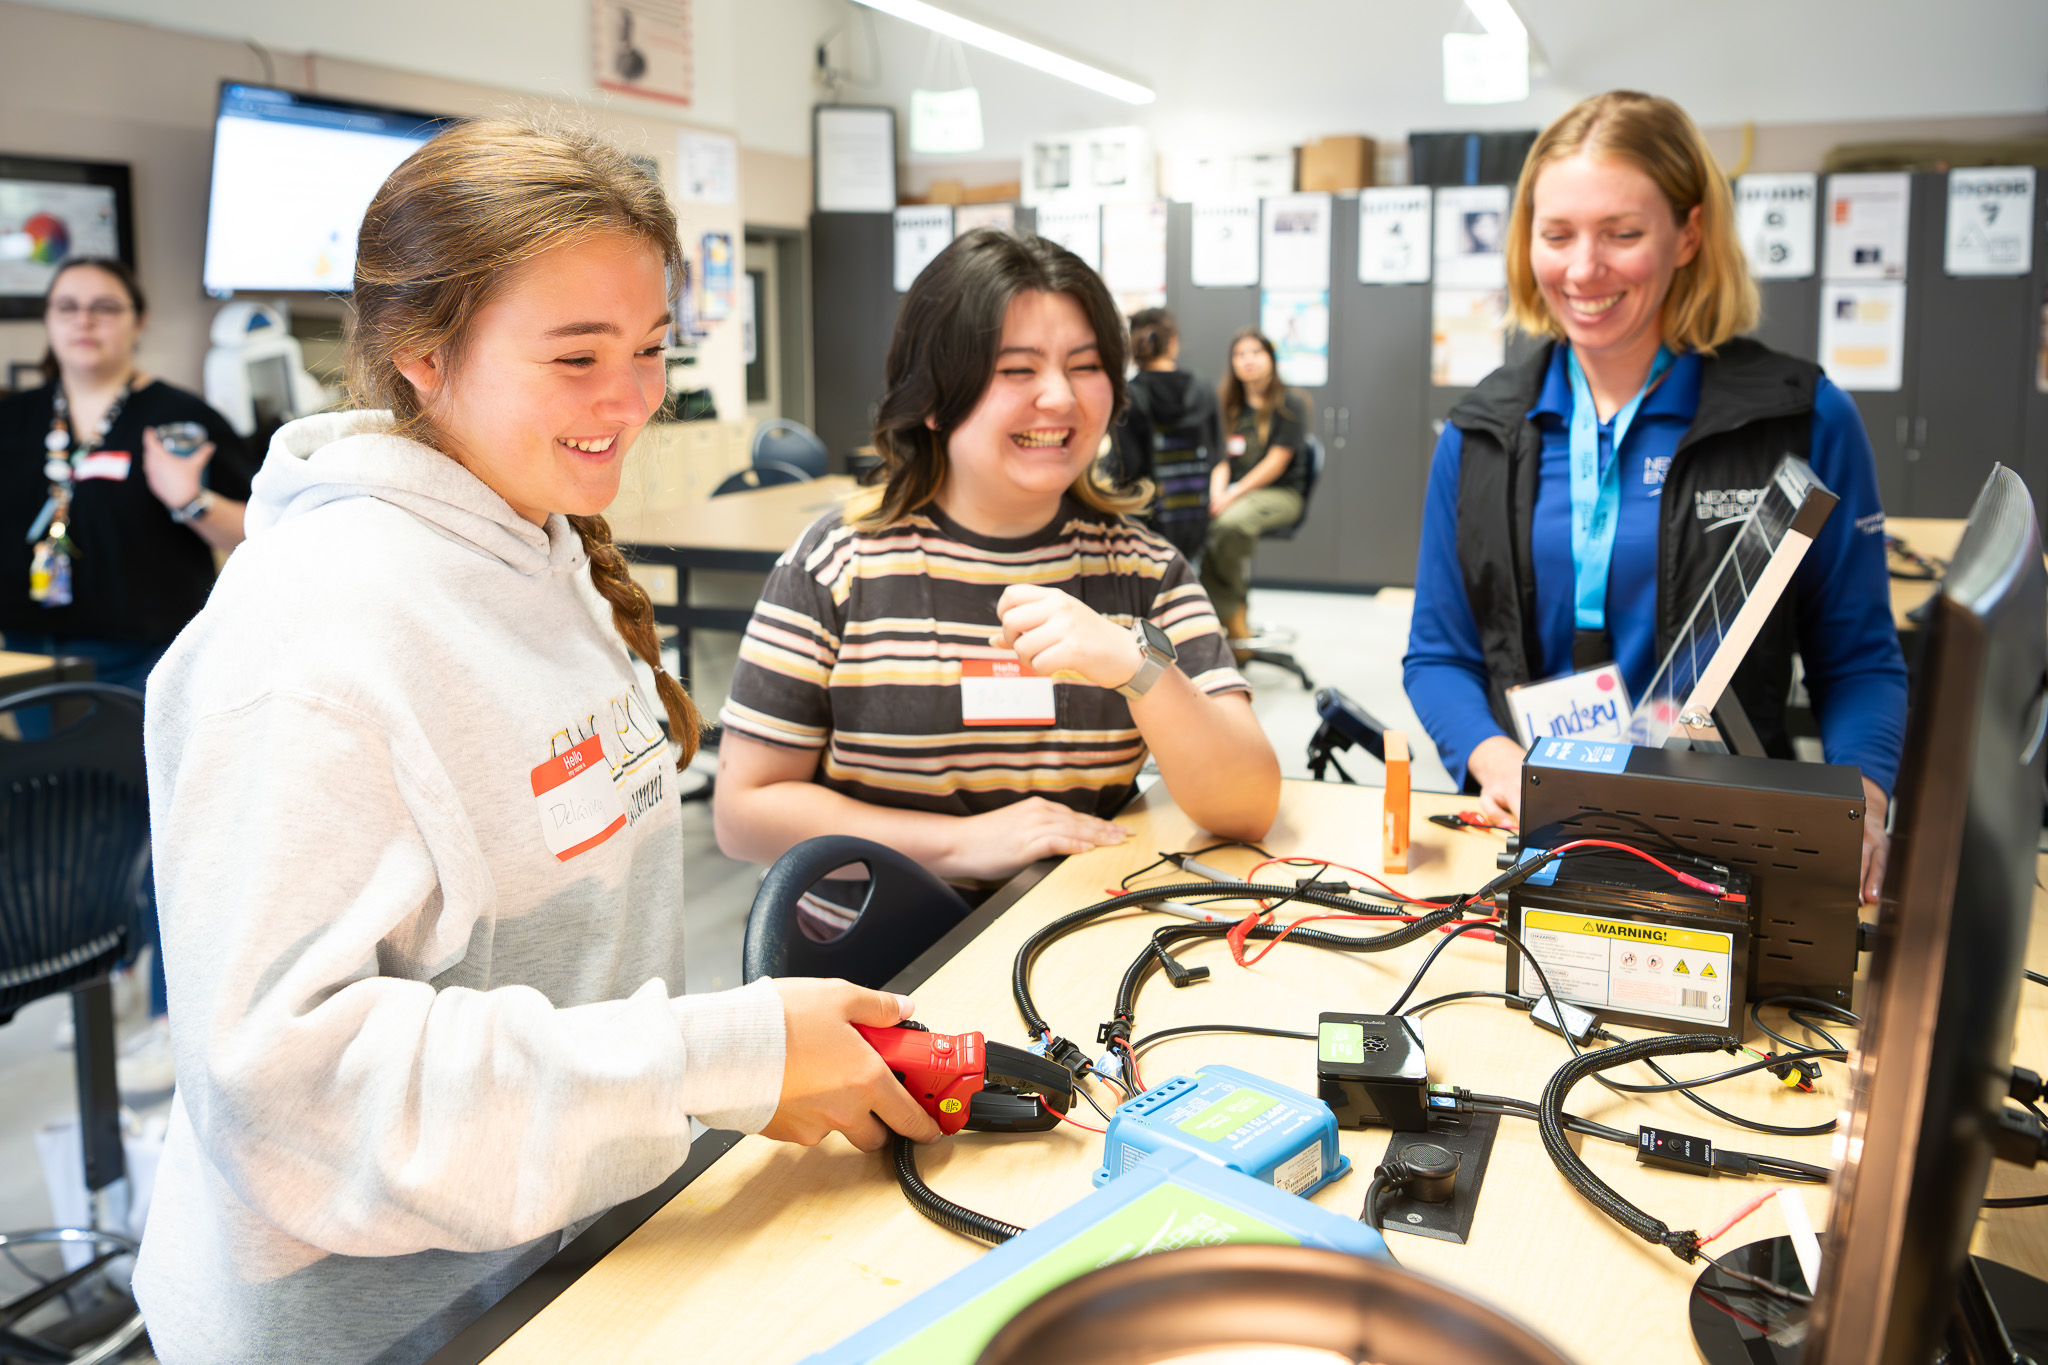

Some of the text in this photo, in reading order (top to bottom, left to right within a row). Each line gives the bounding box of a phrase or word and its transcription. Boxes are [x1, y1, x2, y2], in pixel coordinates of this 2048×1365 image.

[1695, 489, 1763, 504] NEXTer
[992, 662, 1020, 673] Hello
[563, 751, 583, 770] Hello
[1595, 922, 1667, 942] WARNING!
